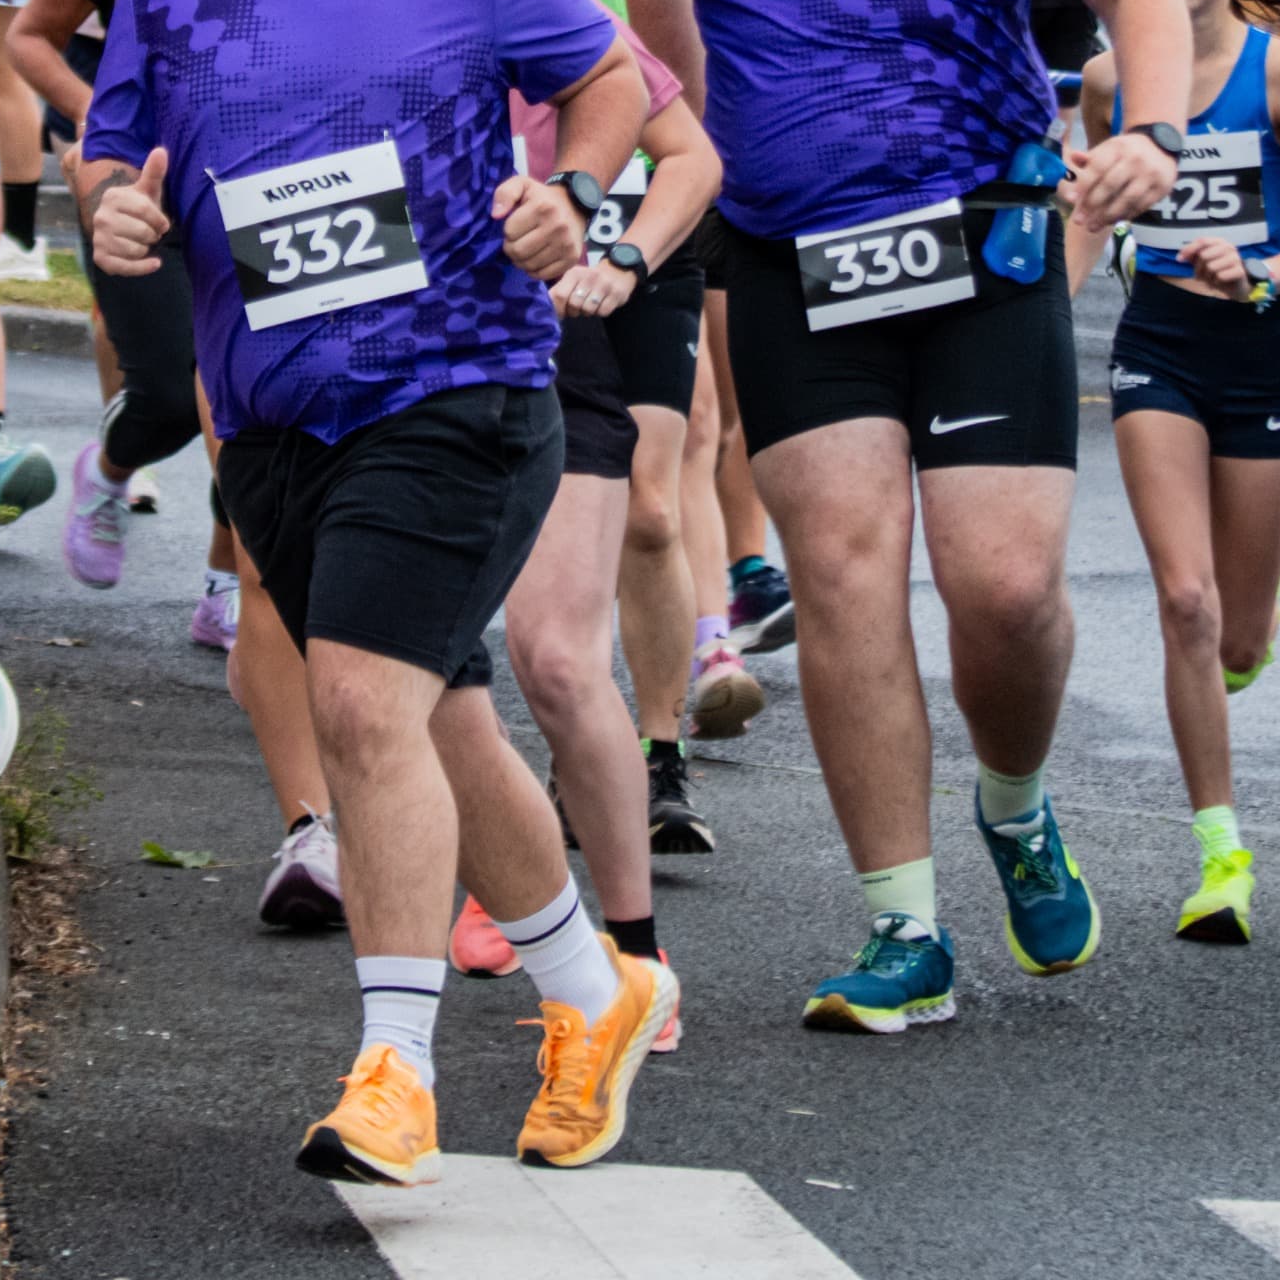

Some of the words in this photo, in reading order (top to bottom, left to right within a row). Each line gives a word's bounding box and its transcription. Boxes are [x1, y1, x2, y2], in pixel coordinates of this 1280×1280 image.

[1179, 148, 1221, 160] RUN
[262, 170, 352, 203] KIPRUN
[259, 207, 385, 284] 332
[824, 229, 941, 293] 330
